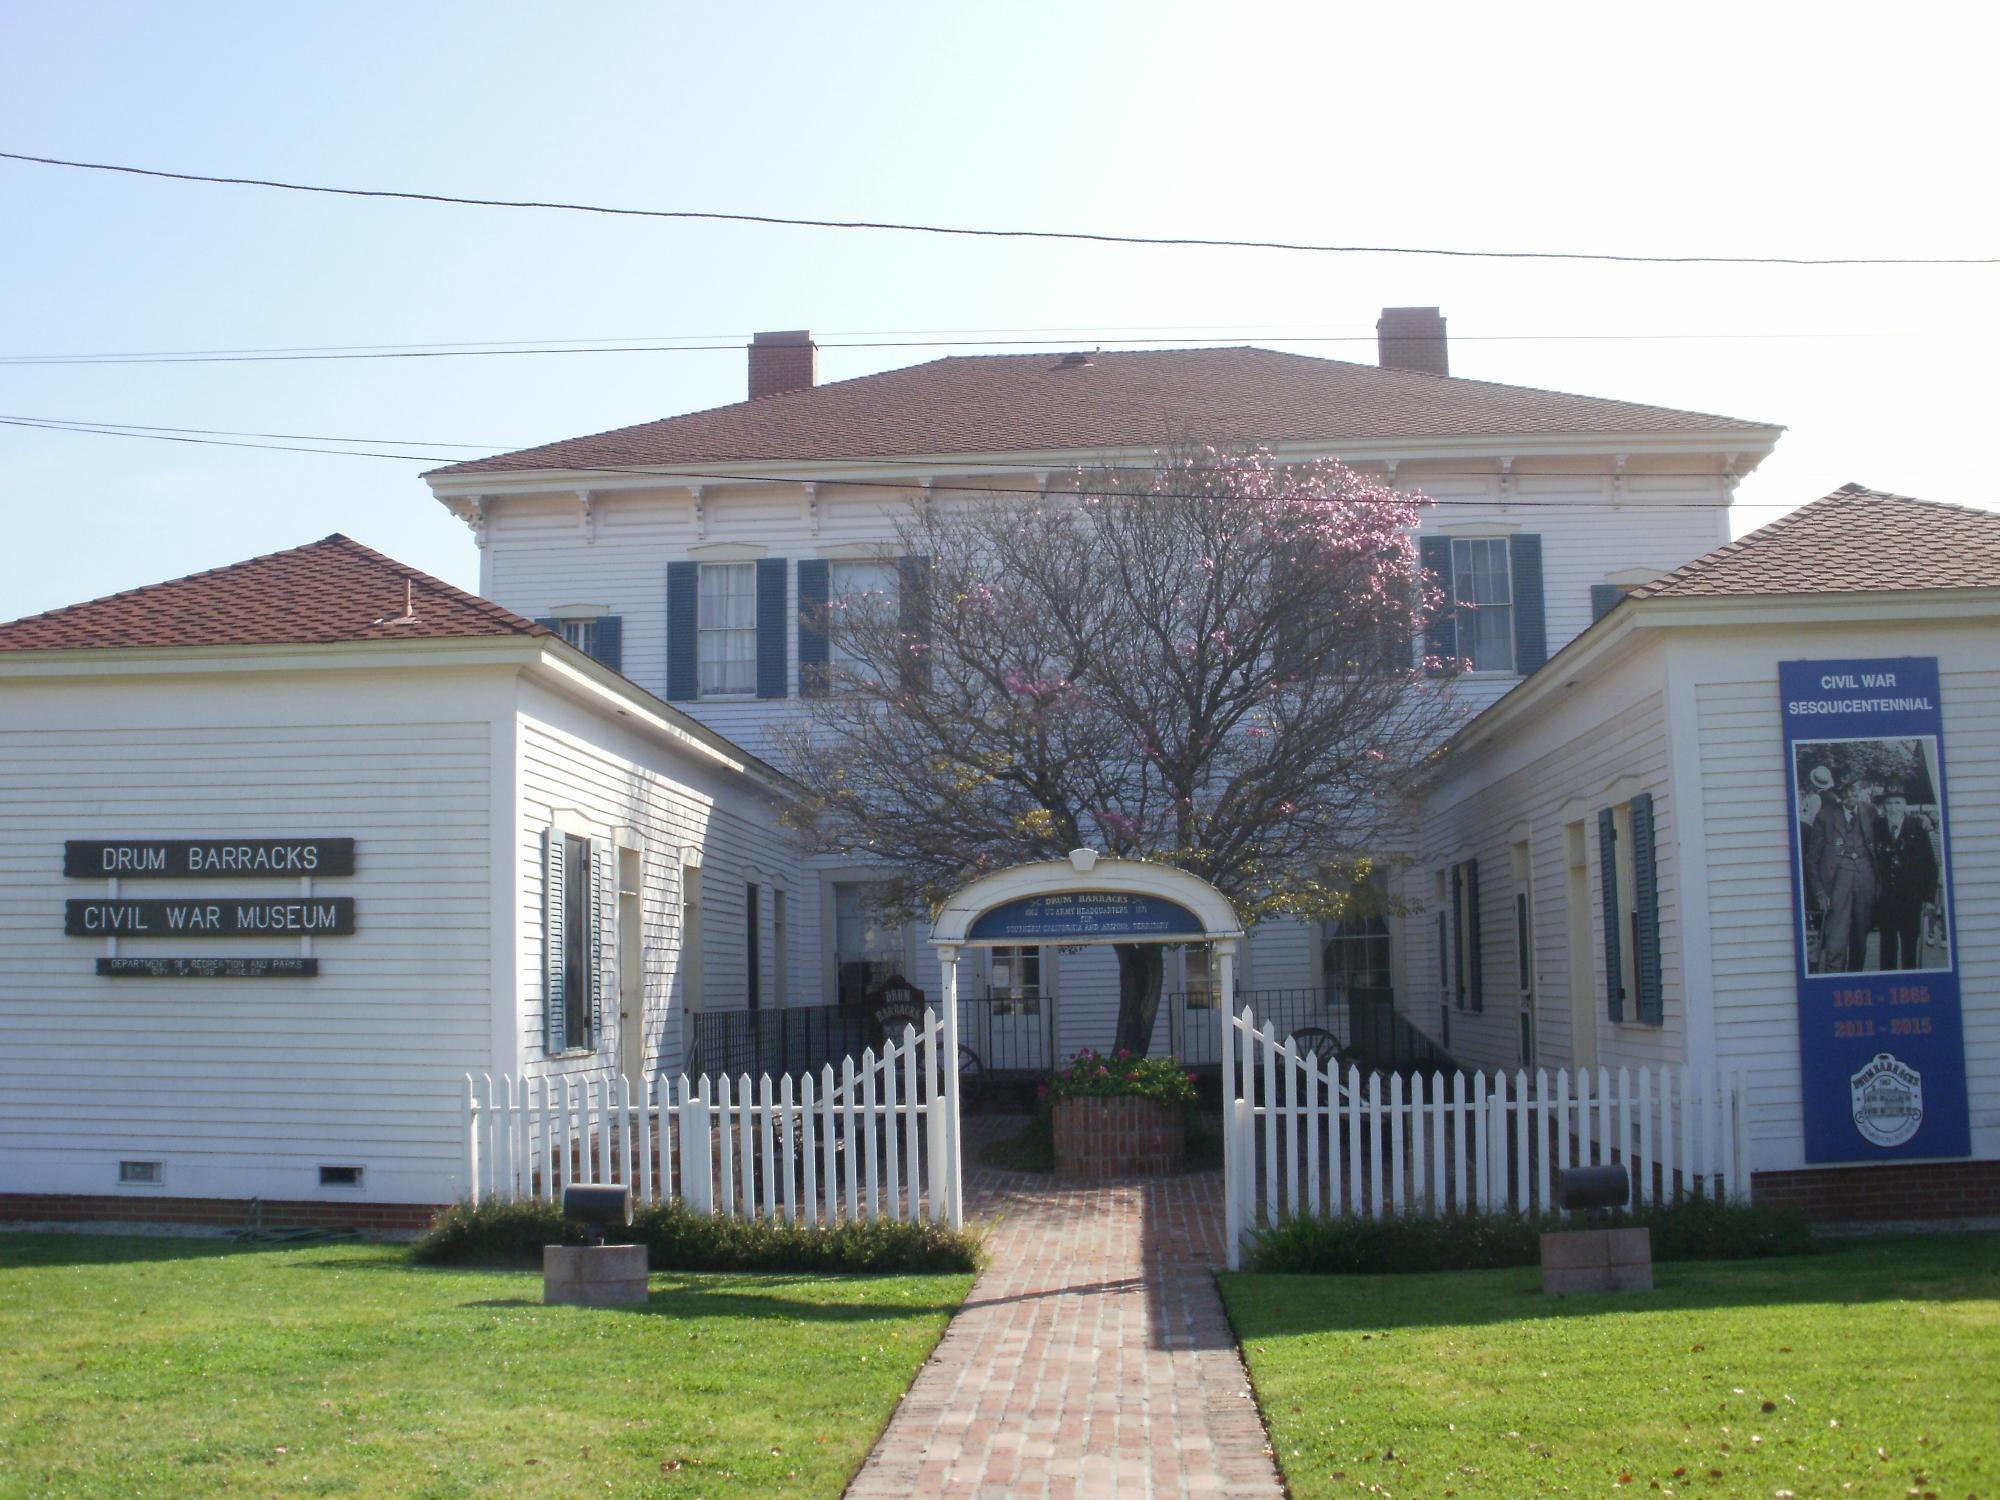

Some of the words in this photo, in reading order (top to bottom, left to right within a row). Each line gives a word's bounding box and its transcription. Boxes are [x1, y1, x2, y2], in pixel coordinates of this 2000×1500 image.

[1821, 675, 1859, 689] CIVIL
[1861, 674, 1896, 688] WAR
[1788, 698, 1933, 714] SESQUICENTENNIAL
[103, 848, 166, 870] DRUM
[189, 846, 319, 870] BARRACKS
[1045, 896, 1072, 905] DRUM
[1078, 895, 1128, 903] BARRACKS
[84, 906, 148, 929] CIVIL
[166, 906, 221, 929] WAR
[237, 905, 336, 929] MUSEUM
[1076, 906, 1128, 915] HEADQUARTERS
[111, 959, 167, 968] DEPARTMENT
[191, 959, 244, 968] RECREATION
[273, 959, 302, 968] PARKS
[1833, 990, 1873, 1008] 1861
[1889, 986, 1930, 1005] 1865
[1834, 1020, 1874, 1038] 2011
[1890, 1017, 1932, 1036] 2015
